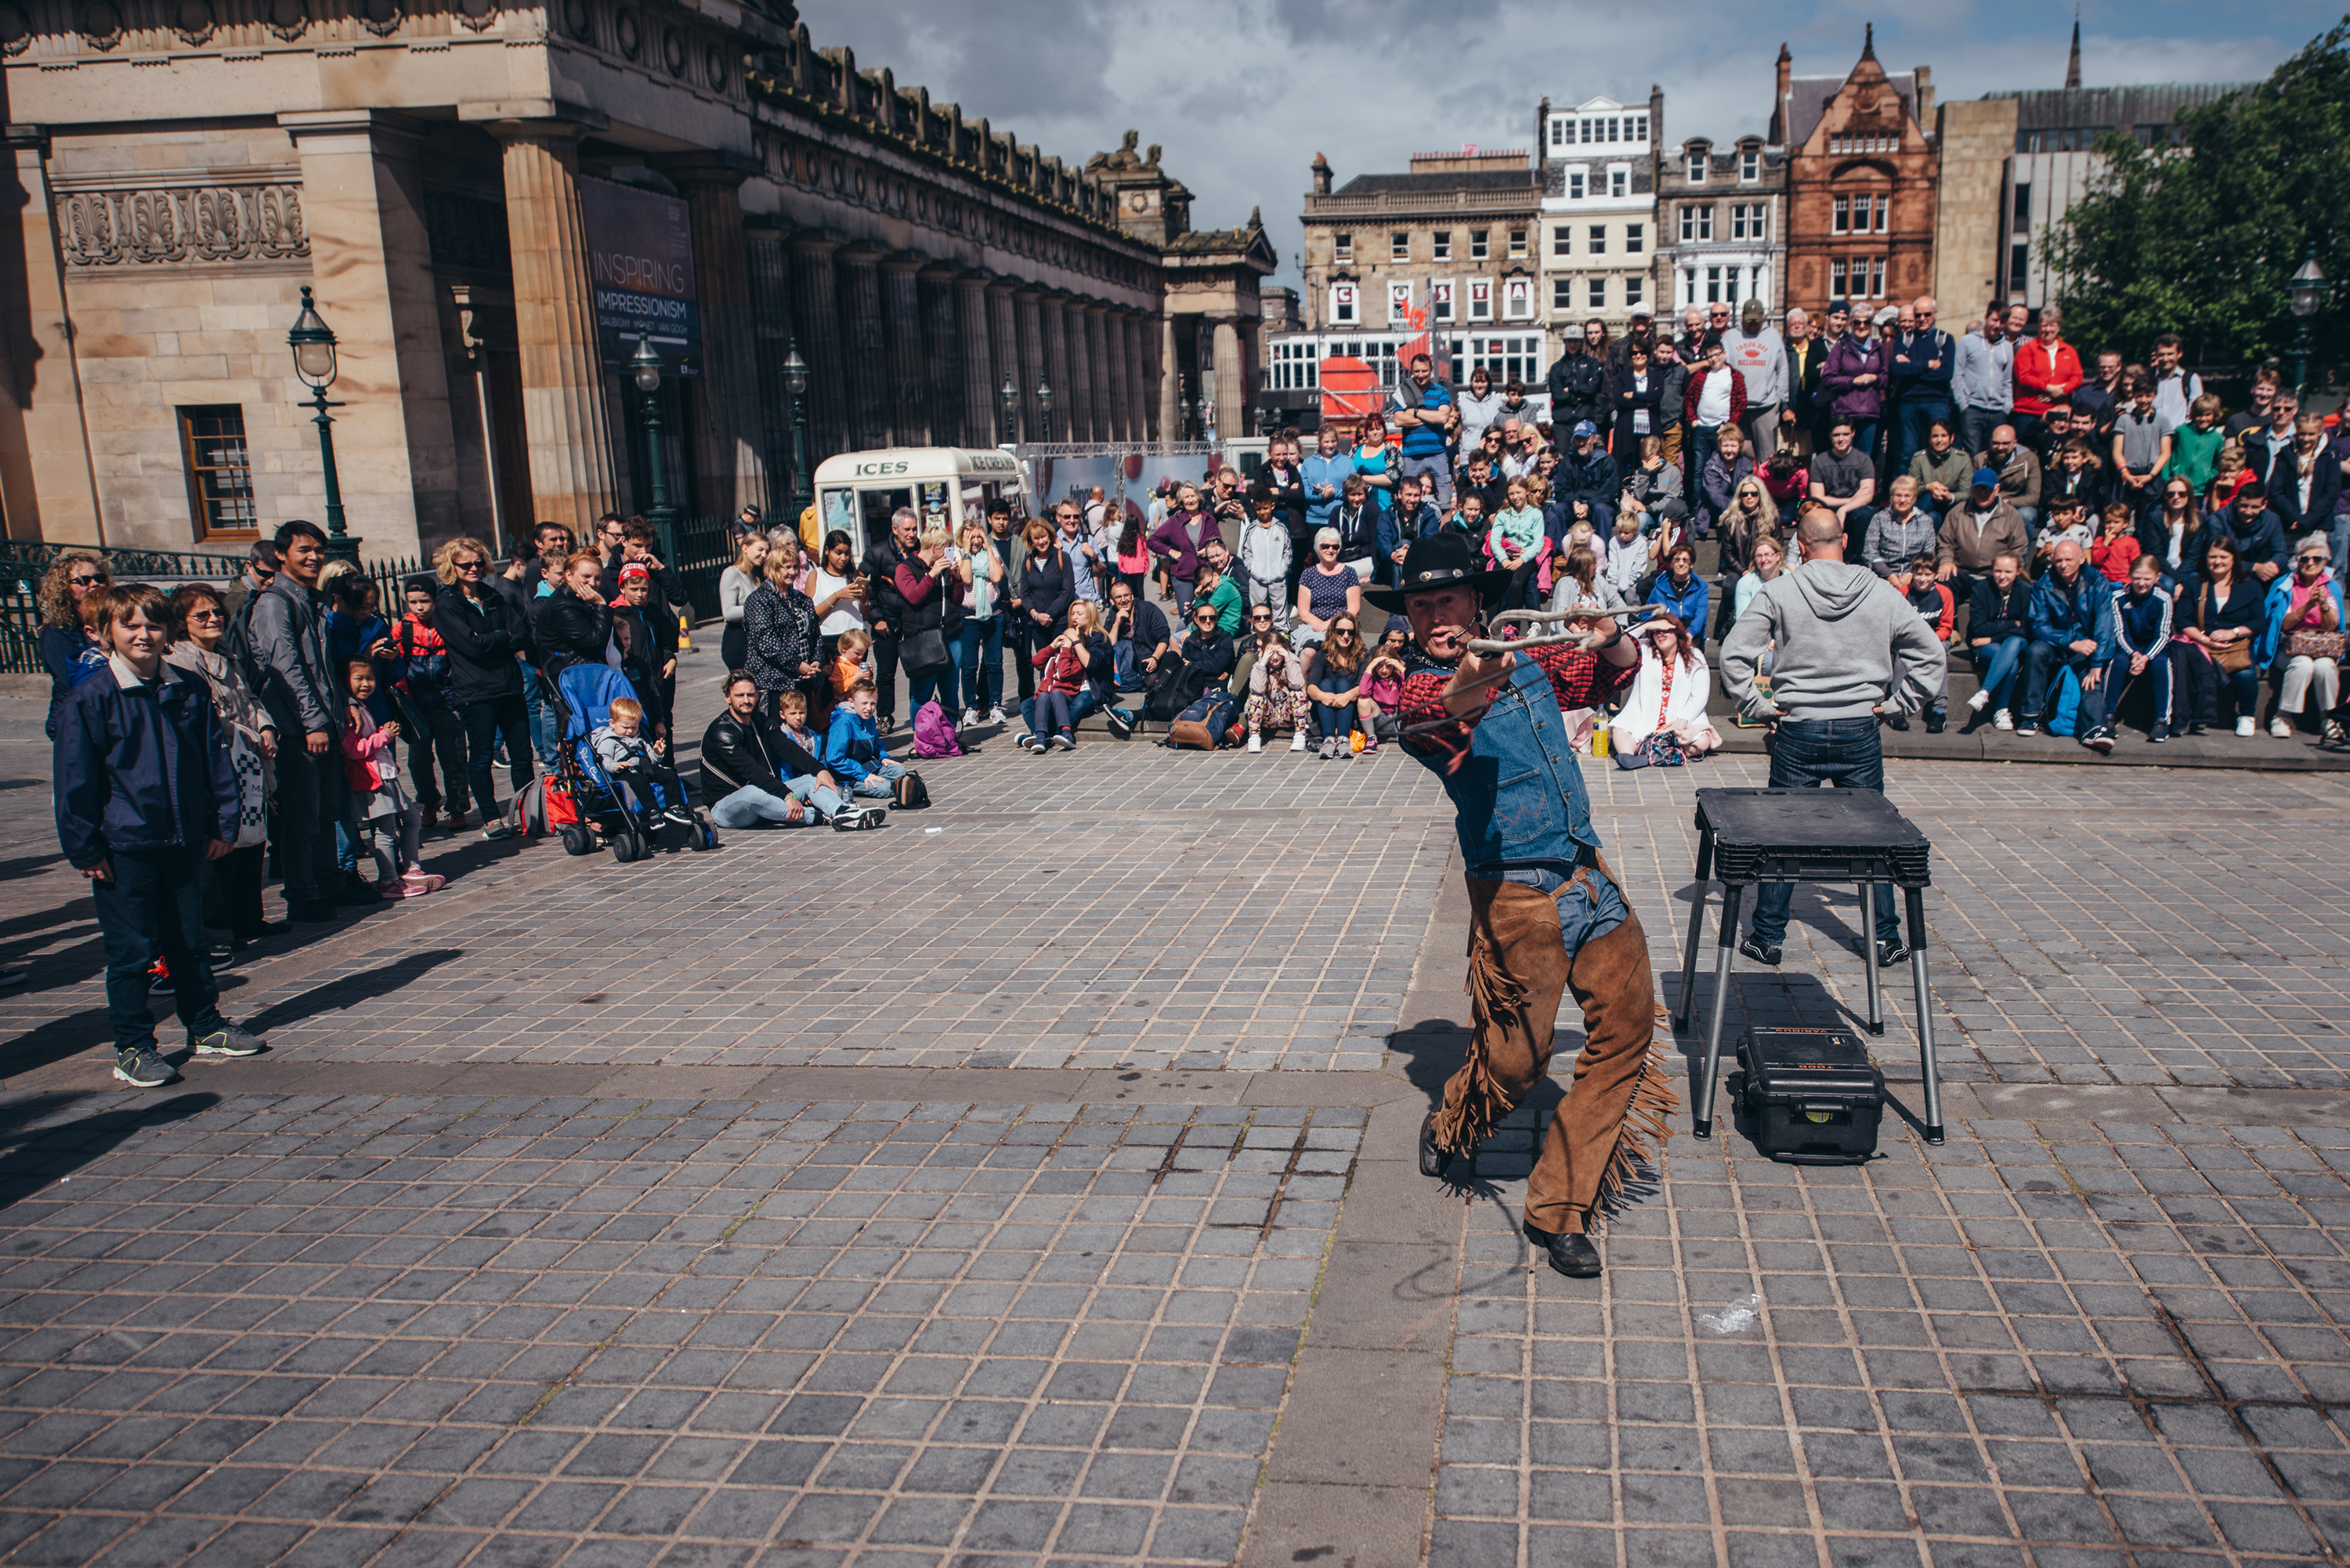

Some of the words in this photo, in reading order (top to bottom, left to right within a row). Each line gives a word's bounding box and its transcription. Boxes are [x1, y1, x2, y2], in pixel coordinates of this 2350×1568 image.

[594, 251, 685, 294] INSPIRING
[597, 291, 687, 320] IMPRESSIONISM
[599, 316, 631, 329] DAUBIGNY
[658, 323, 671, 333] VAN
[671, 323, 688, 334] GOGH
[1735, 341, 1756, 352] TAMPA
[1757, 342, 1769, 352] BAY
[680, 364, 689, 375] EY
[854, 461, 909, 477] ICES
[969, 456, 986, 471] ICE
[984, 456, 1016, 471] CREAMS
